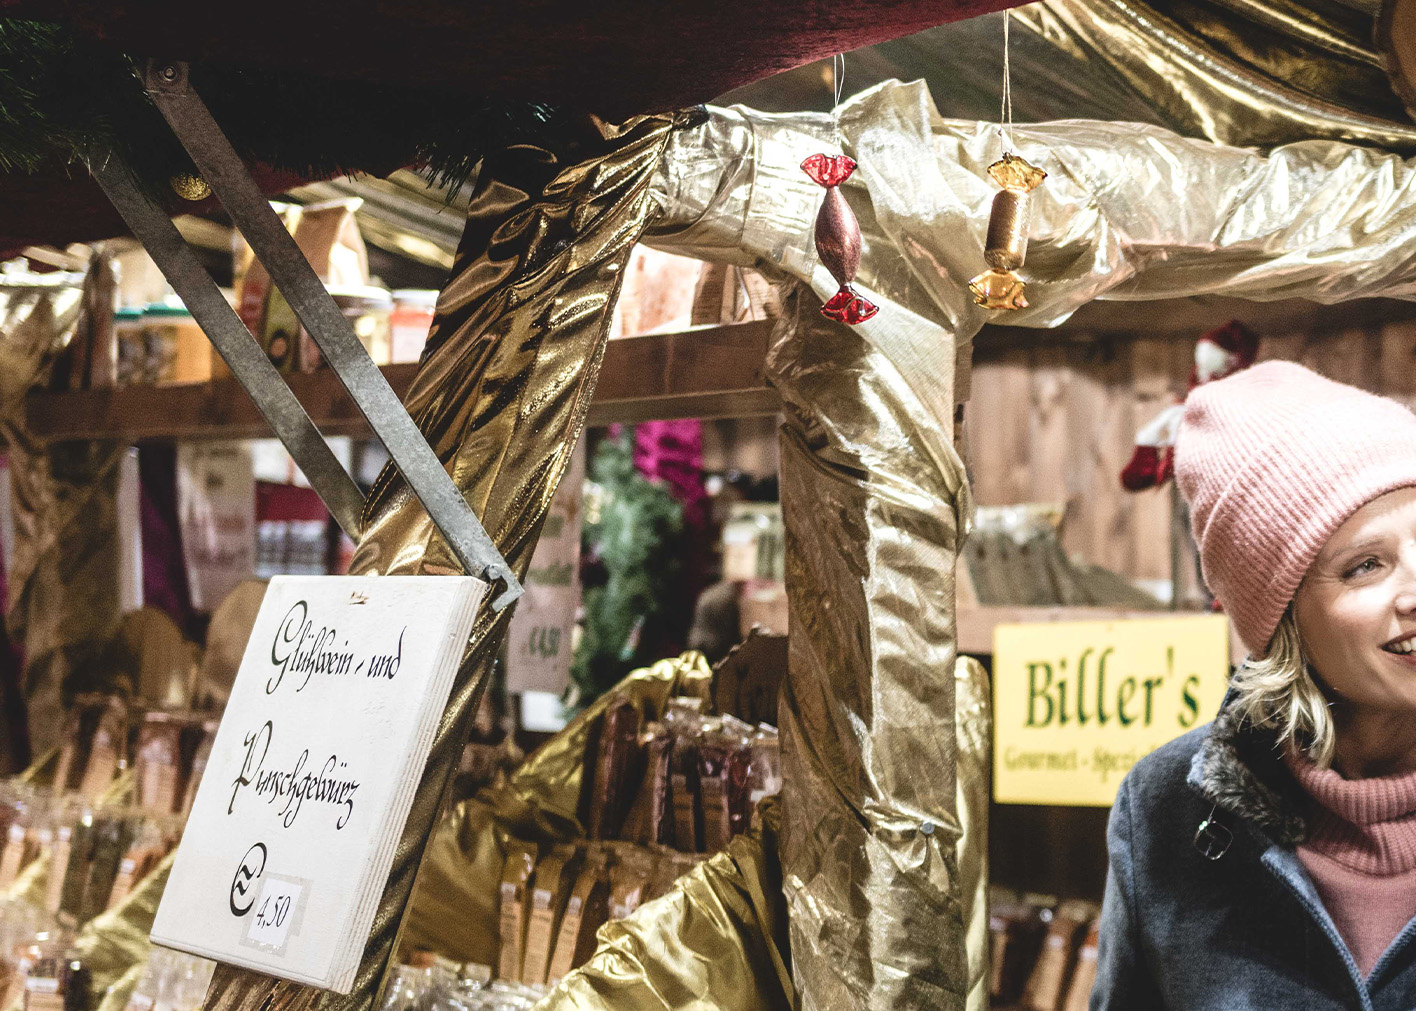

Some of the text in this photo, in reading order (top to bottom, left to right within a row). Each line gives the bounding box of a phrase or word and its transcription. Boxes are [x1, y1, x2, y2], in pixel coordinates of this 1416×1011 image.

[367, 626, 407, 680] und
[1022, 645, 1201, 729] Biller's
[256, 894, 291, 929] 4,50
